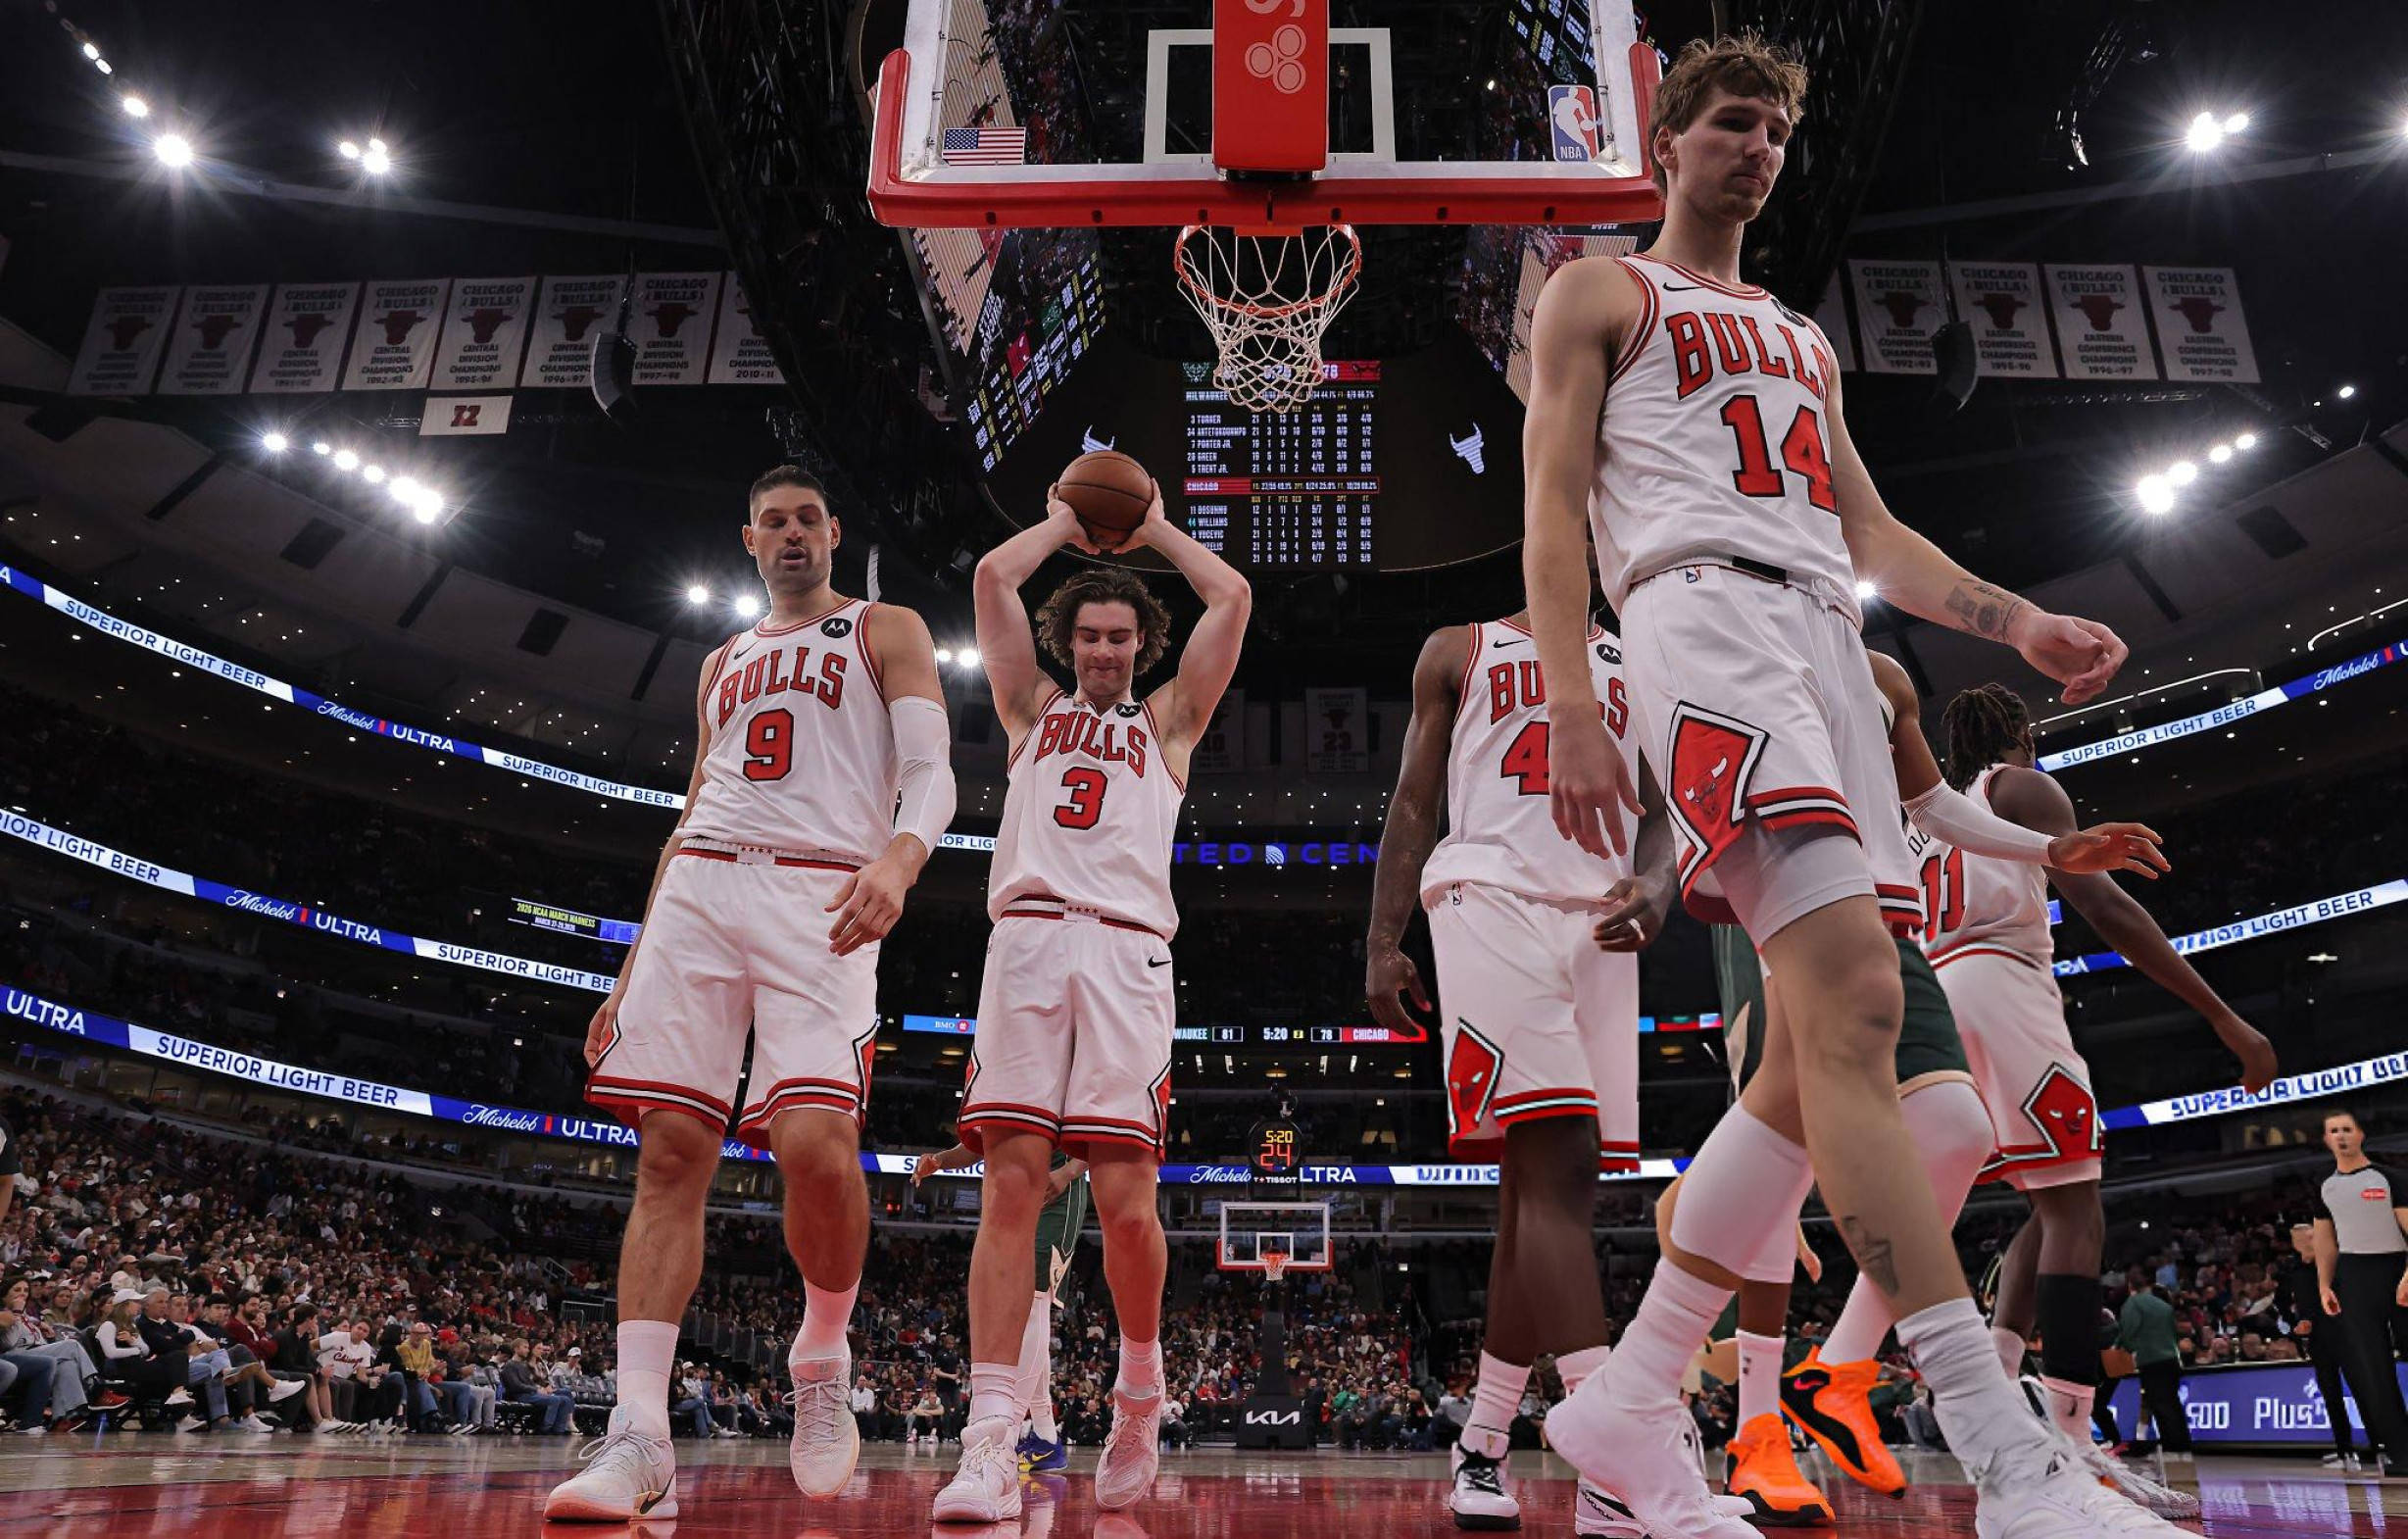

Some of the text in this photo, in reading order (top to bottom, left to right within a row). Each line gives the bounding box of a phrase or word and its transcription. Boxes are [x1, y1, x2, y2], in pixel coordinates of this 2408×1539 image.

[1559, 146, 1584, 160] NBA
[1960, 268, 2028, 280] CHICAGO
[2057, 270, 2125, 282] CHICAGO
[2158, 272, 2225, 284] CHICAGO
[376, 285, 437, 298] CHICAGO
[463, 283, 524, 295] CHICAGO
[553, 280, 616, 293] CHICAGO
[646, 278, 709, 290] CHICAGO
[469, 296, 513, 308] BULLS
[460, 354, 499, 364] DIVISION
[450, 364, 501, 373] CHAMPIONS
[735, 370, 774, 379] 2010-11
[1720, 394, 1841, 517] 14
[1187, 482, 1219, 491] CHICAGO
[1252, 505, 1260, 515] 12
[1188, 518, 1196, 526] 44
[1198, 518, 1228, 526] WILLIAMS
[1267, 518, 1272, 526] 2
[1267, 541, 1272, 551] 2
[65, 600, 268, 689] SUPERIOR LIGHT BEER
[2314, 653, 2380, 691] Michelob
[717, 646, 848, 730] BULLS
[317, 700, 456, 753] Michelob ULTRA
[2062, 699, 2258, 766] SUPERIOR LIGHT BEER
[743, 707, 795, 782] 9
[1034, 711, 1147, 779] BULLS
[502, 754, 674, 807] SUPERIOR LIGHT BEER
[1054, 766, 1108, 830] 3
[47, 830, 107, 867] LIGHT
[110, 853, 160, 883] BEER
[1920, 846, 1966, 942] 11
[225, 888, 382, 946] Michelob ULTRA
[549, 910, 569, 922] MARCH
[568, 914, 596, 928] MADNESS
[2251, 890, 2374, 933] LIGHT BEER
[438, 943, 530, 977] SUPERIOR
[532, 964, 586, 989] LIGHT
[6, 988, 86, 1036] ULTRA
[935, 1020, 956, 1029] BMO
[1221, 1029, 1234, 1040] 81
[1263, 1027, 1289, 1041] 5:20
[1320, 1029, 1333, 1040] 78
[1352, 1029, 1390, 1041] CHICAGO
[157, 1034, 399, 1108] SUPERIOR LIGHT BEER
[462, 1104, 639, 1146] Michelob ULTRA
[1265, 1129, 1294, 1144] 5:20
[1259, 1142, 1292, 1167] 24
[1189, 1166, 1252, 1184] Michelo
[1299, 1167, 1356, 1183] LTRA
